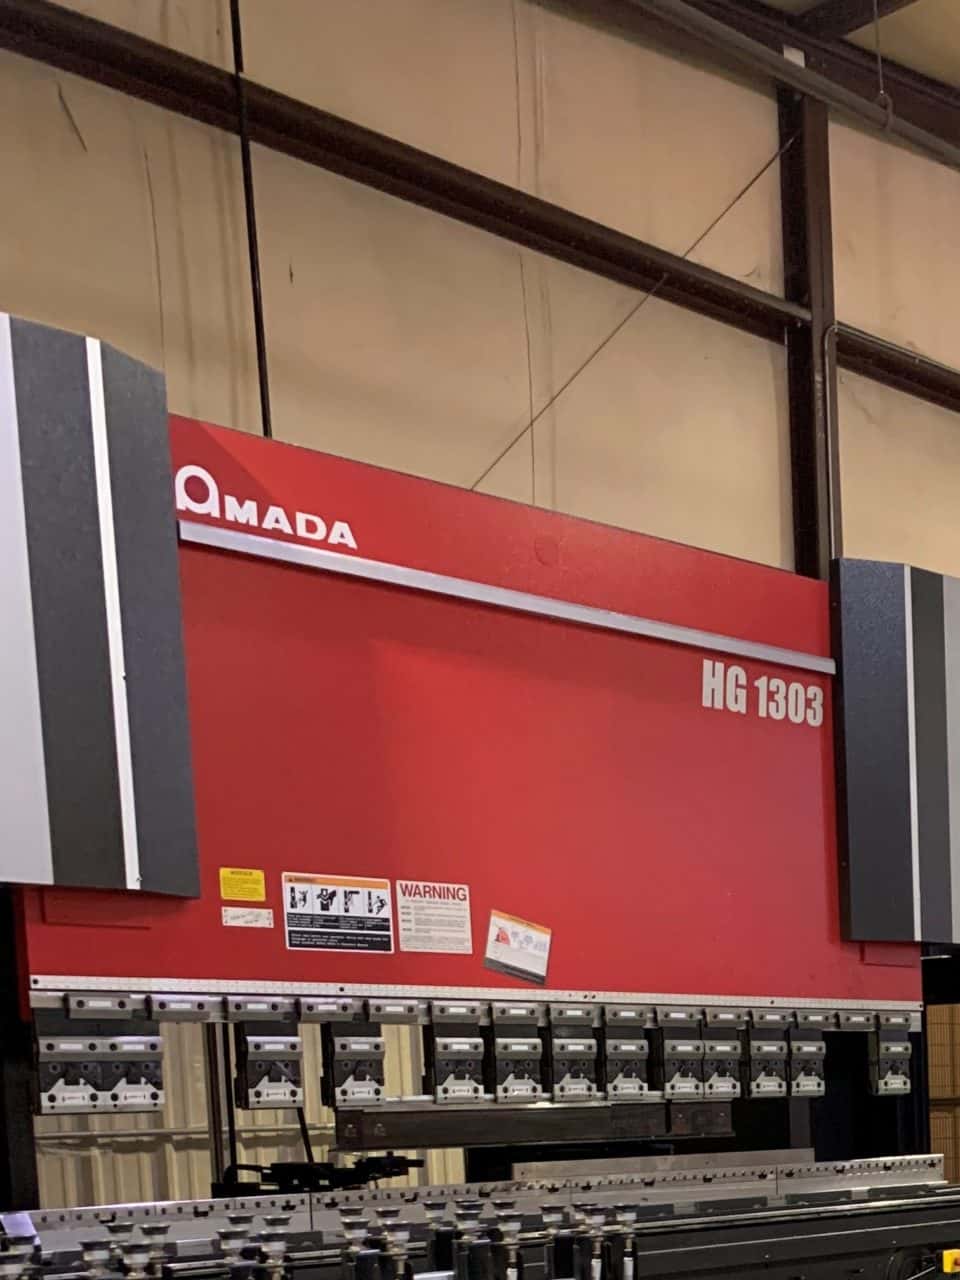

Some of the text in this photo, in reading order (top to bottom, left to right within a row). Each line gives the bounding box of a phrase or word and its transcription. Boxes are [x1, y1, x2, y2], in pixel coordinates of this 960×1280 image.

[175, 465, 357, 549] AMADA
[702, 659, 823, 727] HG 1303
[400, 883, 467, 901] WARNING
